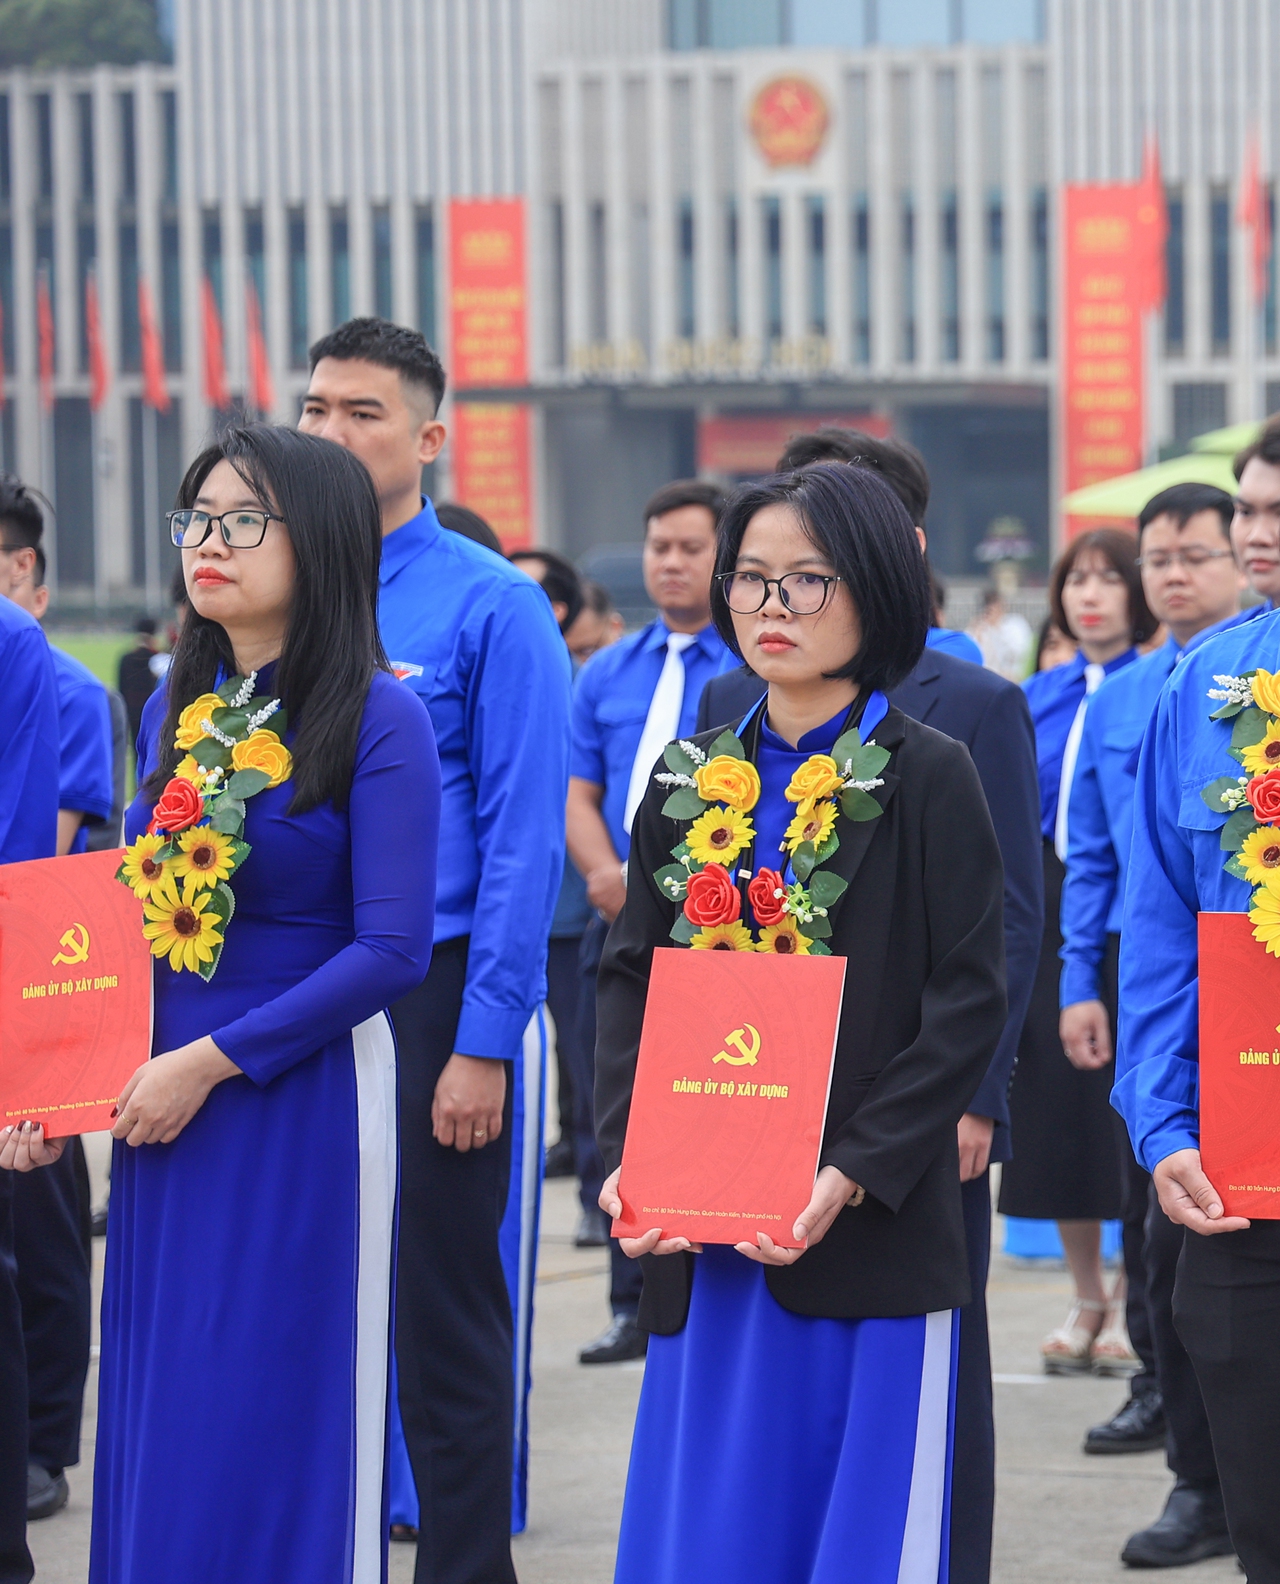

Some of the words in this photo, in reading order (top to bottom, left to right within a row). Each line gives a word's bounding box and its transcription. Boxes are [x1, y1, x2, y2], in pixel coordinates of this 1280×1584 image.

[22, 983, 46, 999] ĐẢNG
[48, 980, 60, 996] ỦY
[62, 979, 74, 995] BỘ
[76, 977, 92, 992] XÂY
[94, 975, 118, 991] DỰNG
[1240, 1048, 1270, 1064] ĐẢNG
[672, 1077, 702, 1093] ĐẢNG
[704, 1078, 718, 1094] ỦY
[720, 1081, 734, 1097] BỘ
[736, 1082, 758, 1096] XÂY
[760, 1084, 788, 1099] DỰNG
